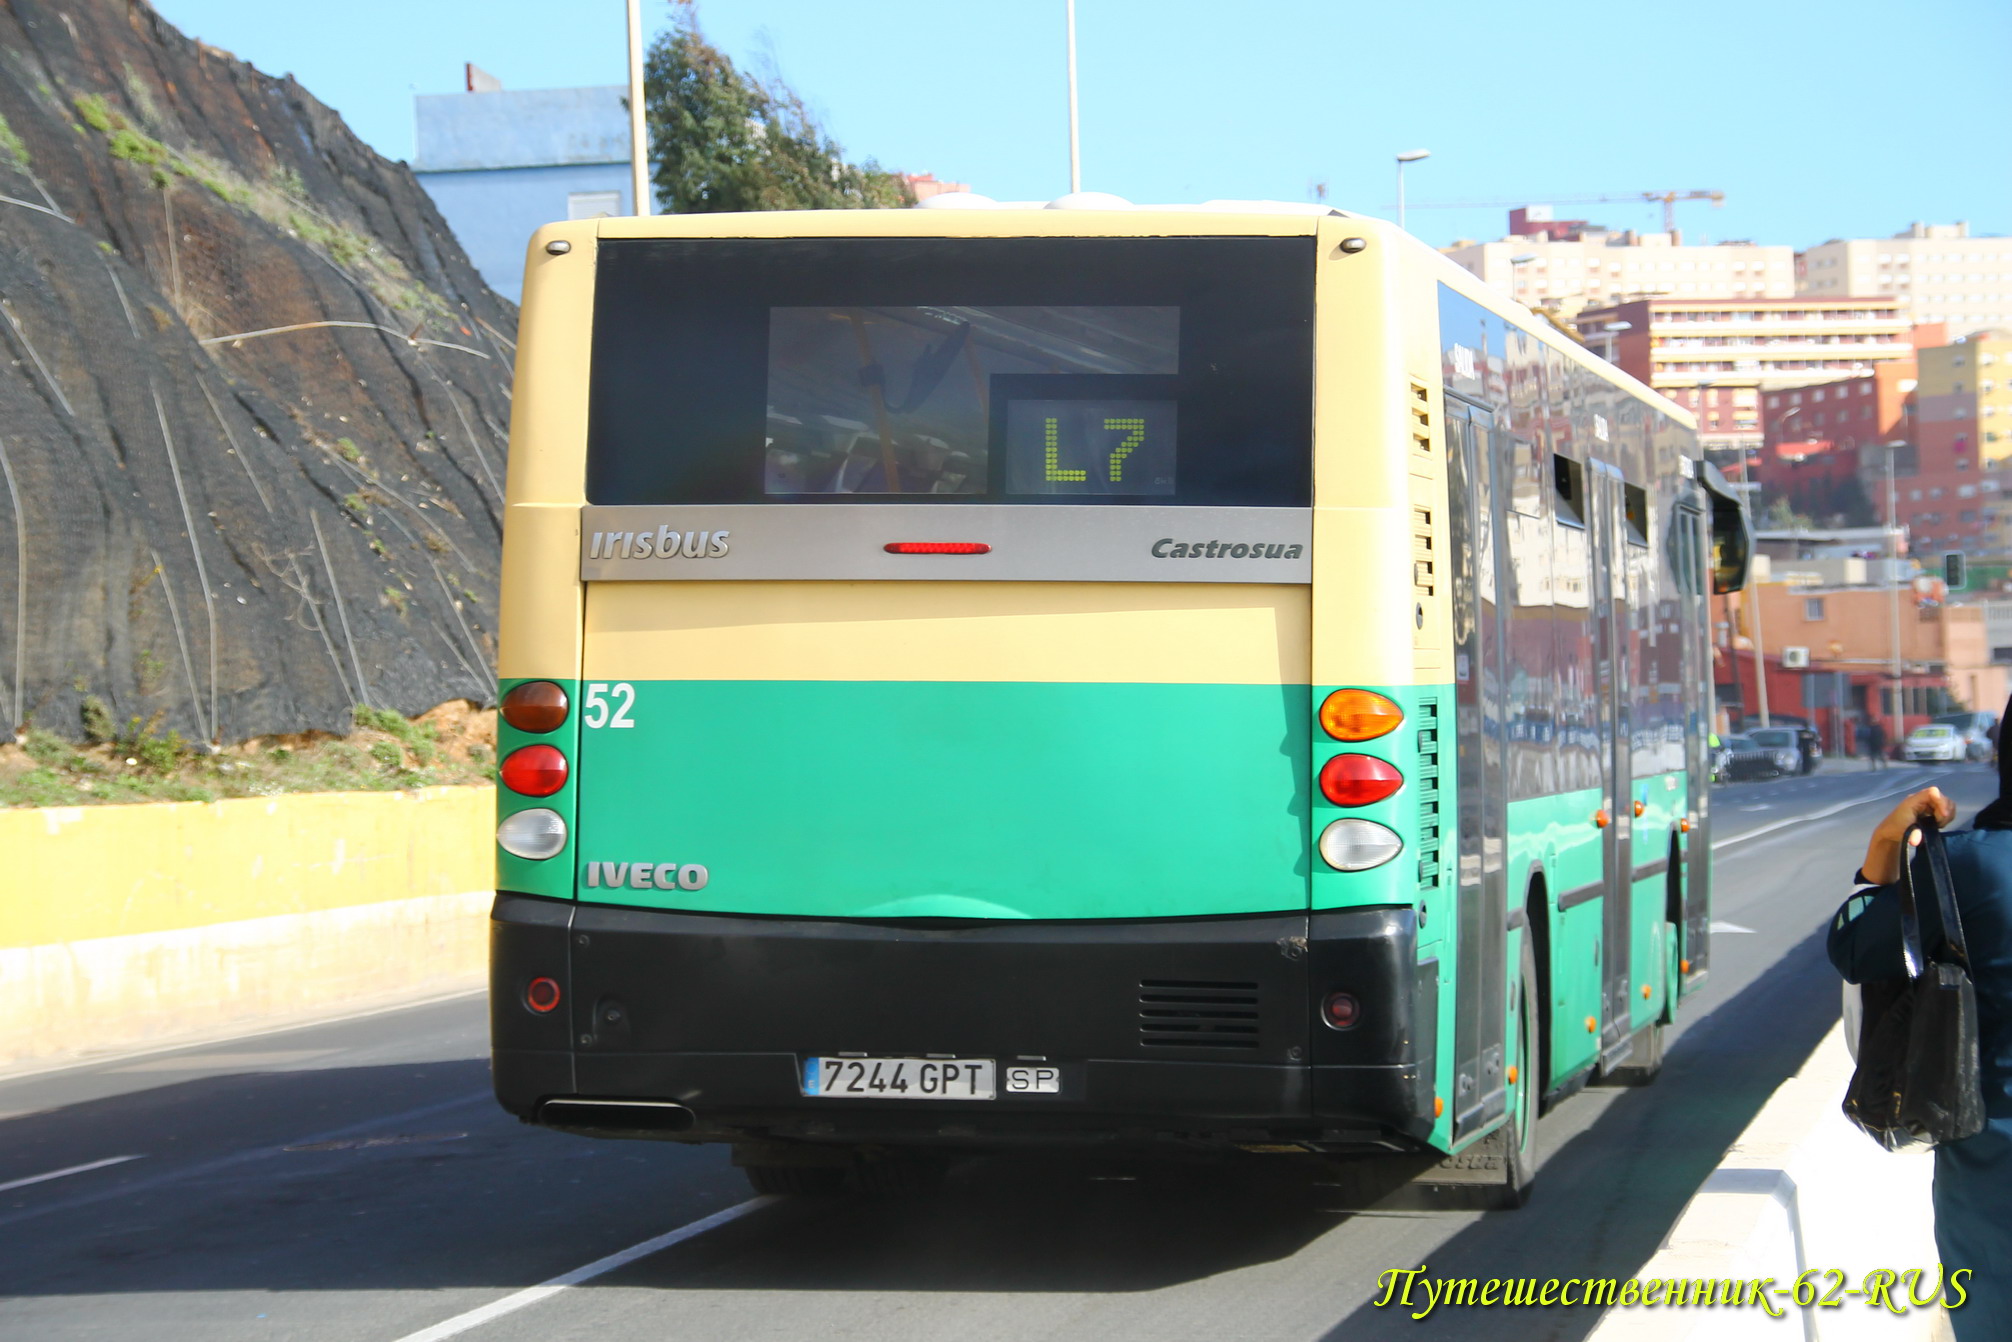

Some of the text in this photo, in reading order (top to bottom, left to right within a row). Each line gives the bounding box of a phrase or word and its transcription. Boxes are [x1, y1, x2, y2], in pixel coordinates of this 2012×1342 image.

[1045, 417, 1145, 482] L 7
[1151, 537, 1304, 560] Castrosua
[583, 682, 636, 729] 52
[586, 861, 709, 891] IVECO
[824, 1060, 983, 1095] 7244 GPT
[1011, 1069, 1054, 1090] SP
